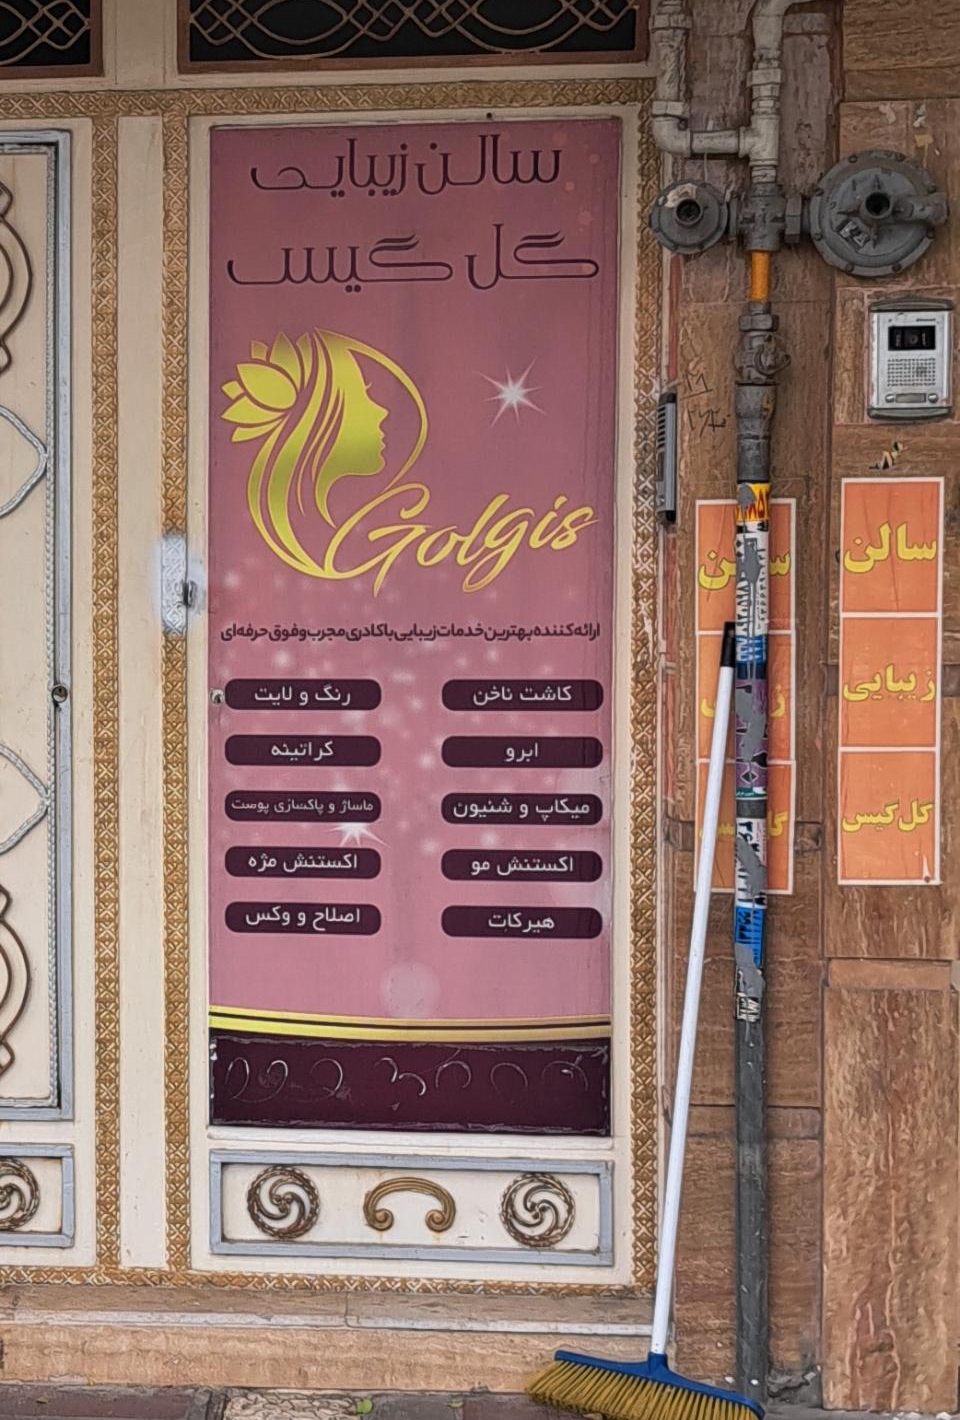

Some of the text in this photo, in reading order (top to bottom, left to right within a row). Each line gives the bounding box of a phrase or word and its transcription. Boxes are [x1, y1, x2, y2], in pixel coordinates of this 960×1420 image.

[250, 133, 562, 198] سالن زیبایی
[227, 223, 599, 293] گل گیس
[324, 482, 600, 597] Golgis
[843, 521, 938, 574] سالن
[269, 623, 298, 641] فوق
[307, 627, 345, 641] مجرب
[346, 623, 384, 641] کادری
[394, 623, 438, 641] زیبایی
[437, 623, 484, 637] خدمات
[484, 624, 533, 641] بهترین
[534, 623, 575, 637] کننده
[575, 623, 600, 641] ارائه
[842, 664, 937, 702] زیبایی
[254, 685, 351, 706] رنگ و لایت
[473, 685, 572, 706] کاشت ناخن
[271, 741, 334, 761] کراتینه
[504, 742, 538, 762] ابرو
[231, 799, 373, 815] ماساژ و پاکسازی پوست
[453, 798, 590, 821] میکاپ و شنیون
[248, 853, 357, 872] اکستنش مژه
[471, 856, 573, 875] اکستنش مو
[245, 906, 360, 930] اصلاح و وکس
[488, 913, 554, 933] هیرکات
